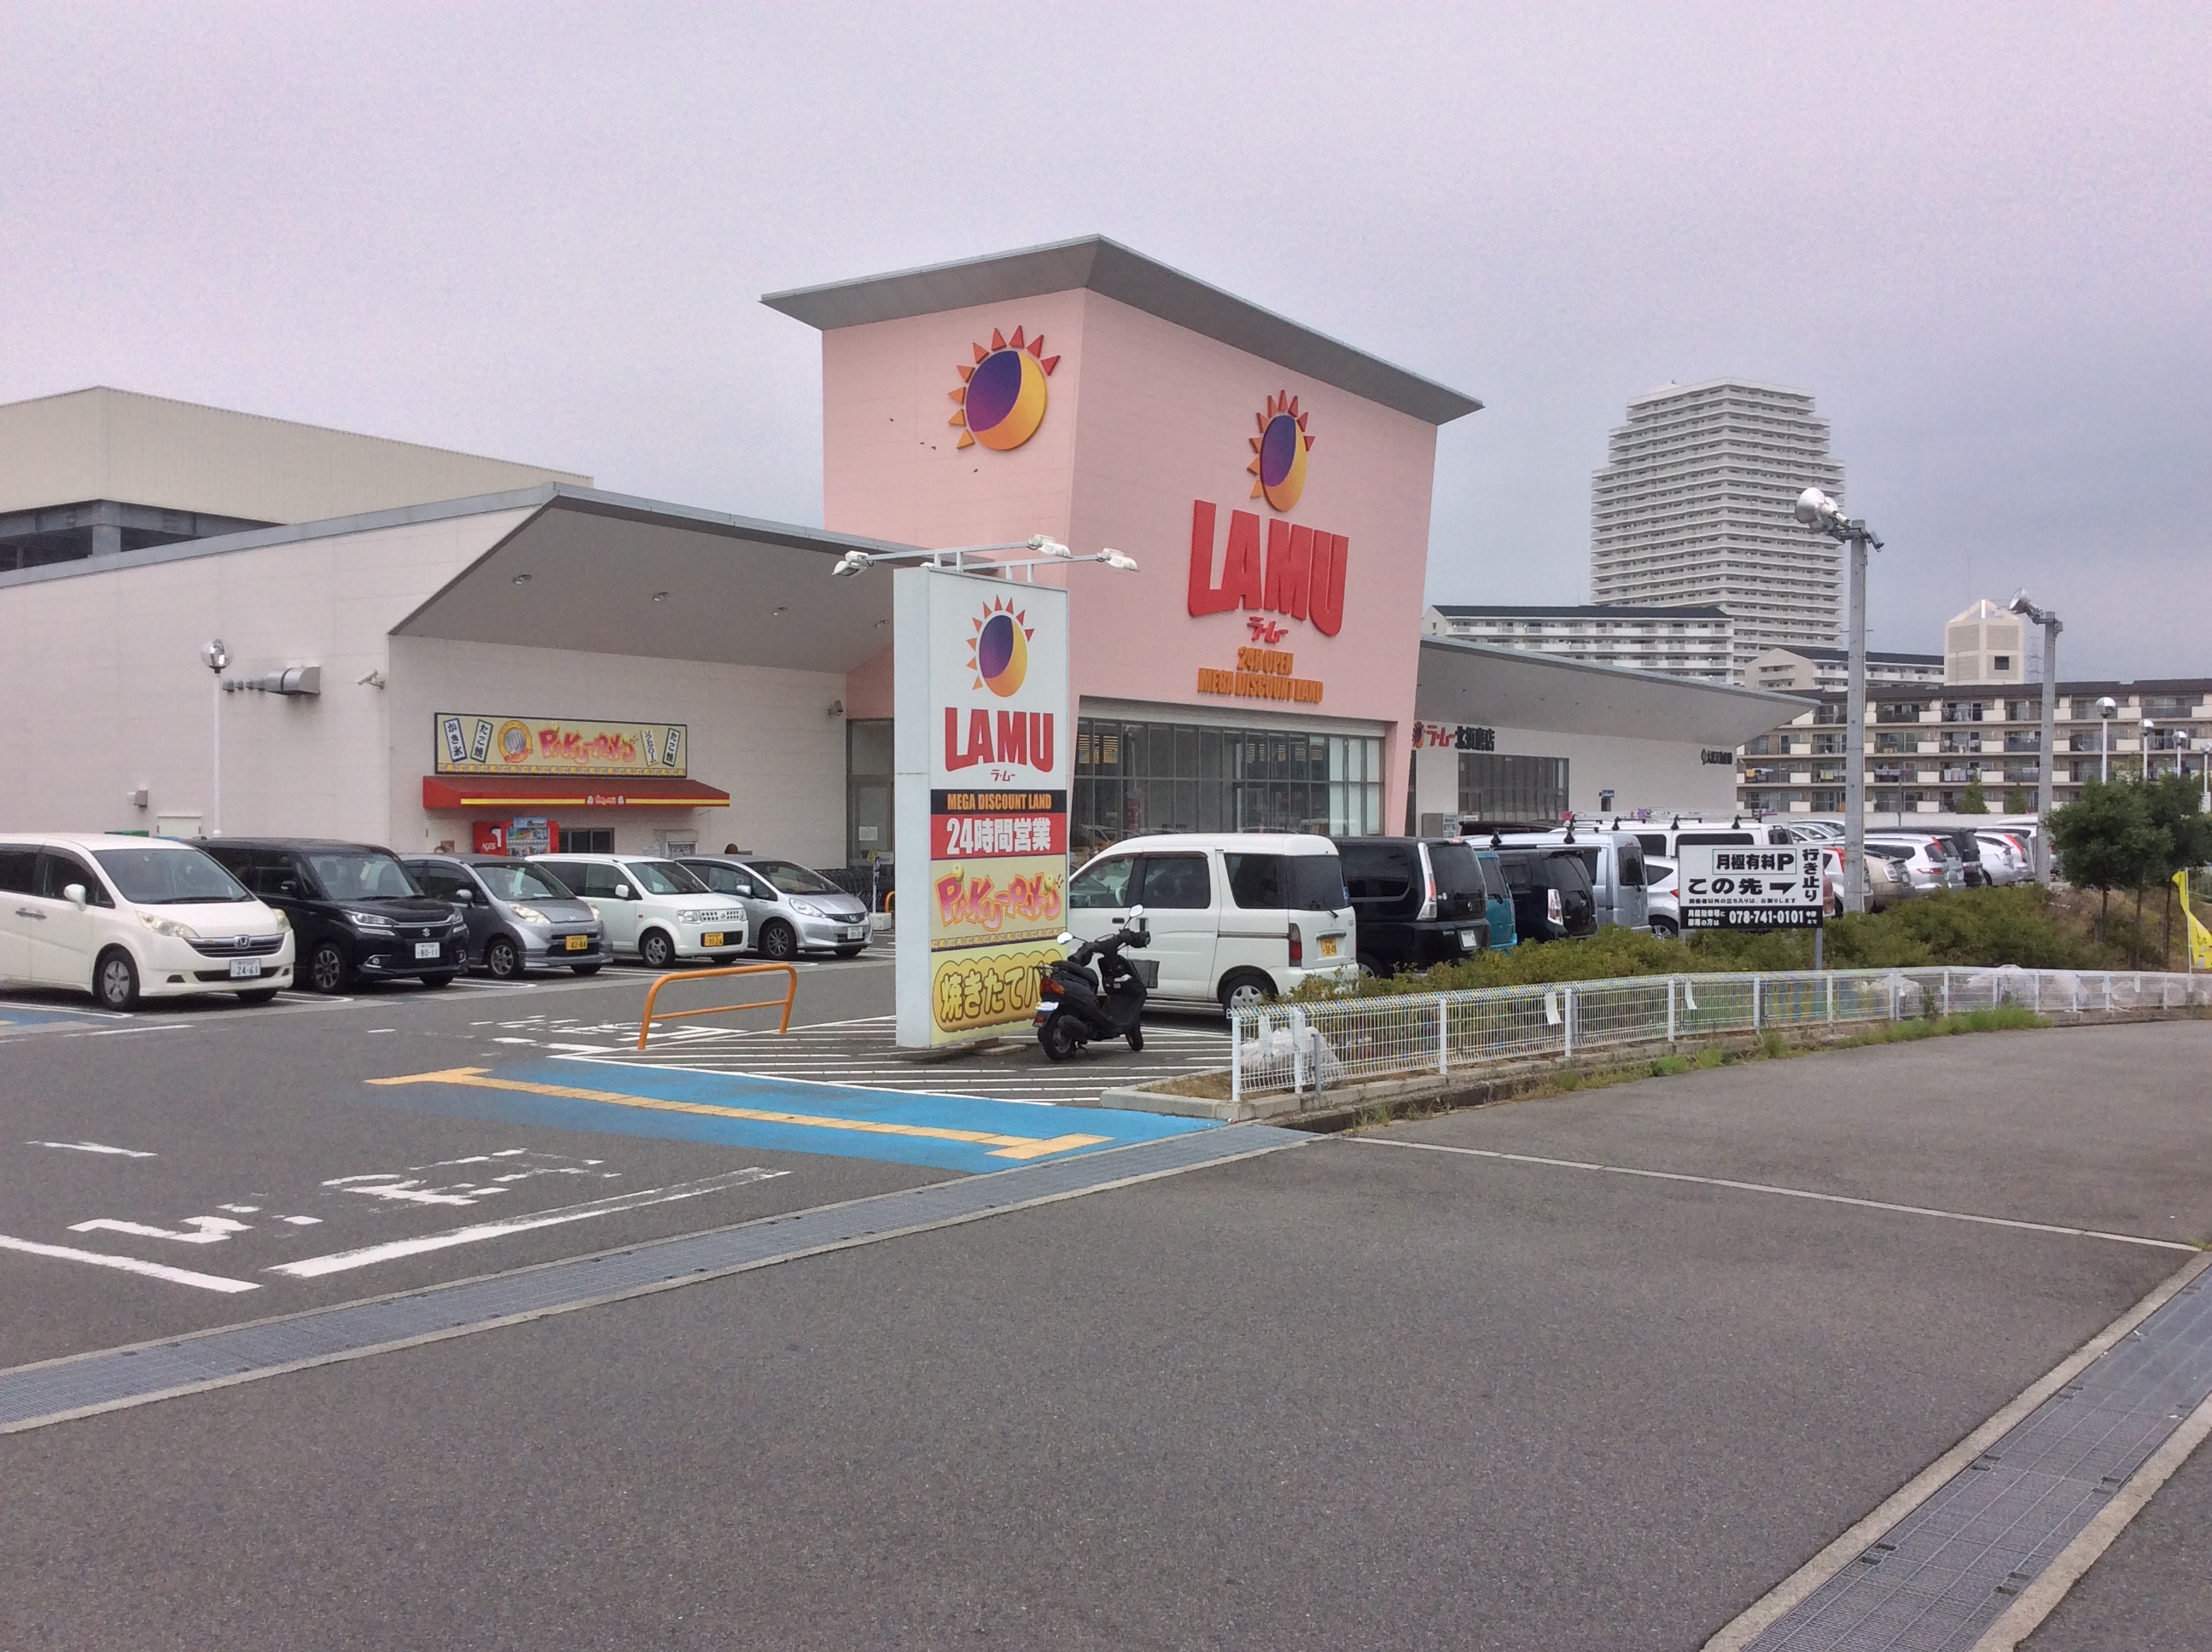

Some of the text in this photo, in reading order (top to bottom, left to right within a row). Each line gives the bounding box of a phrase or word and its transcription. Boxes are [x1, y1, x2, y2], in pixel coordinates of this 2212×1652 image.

[1188, 499, 1349, 637] LAMU
[1237, 647, 1294, 675] 24H OPEN
[1197, 667, 1323, 703] MEGA DISCOUNT LAND
[448, 723, 463, 757] かき氷
[474, 724, 488, 759] たこ焼
[945, 707, 1054, 772] LAMU
[947, 794, 1052, 810] MEGA DISCOUNT LAND
[946, 817, 1051, 855] 24時間営業
[1716, 853, 1795, 871] 月極有料P
[1802, 848, 1820, 903] 行き止り
[1688, 877, 1763, 895] この先
[1729, 910, 1804, 924] 078-741-0101
